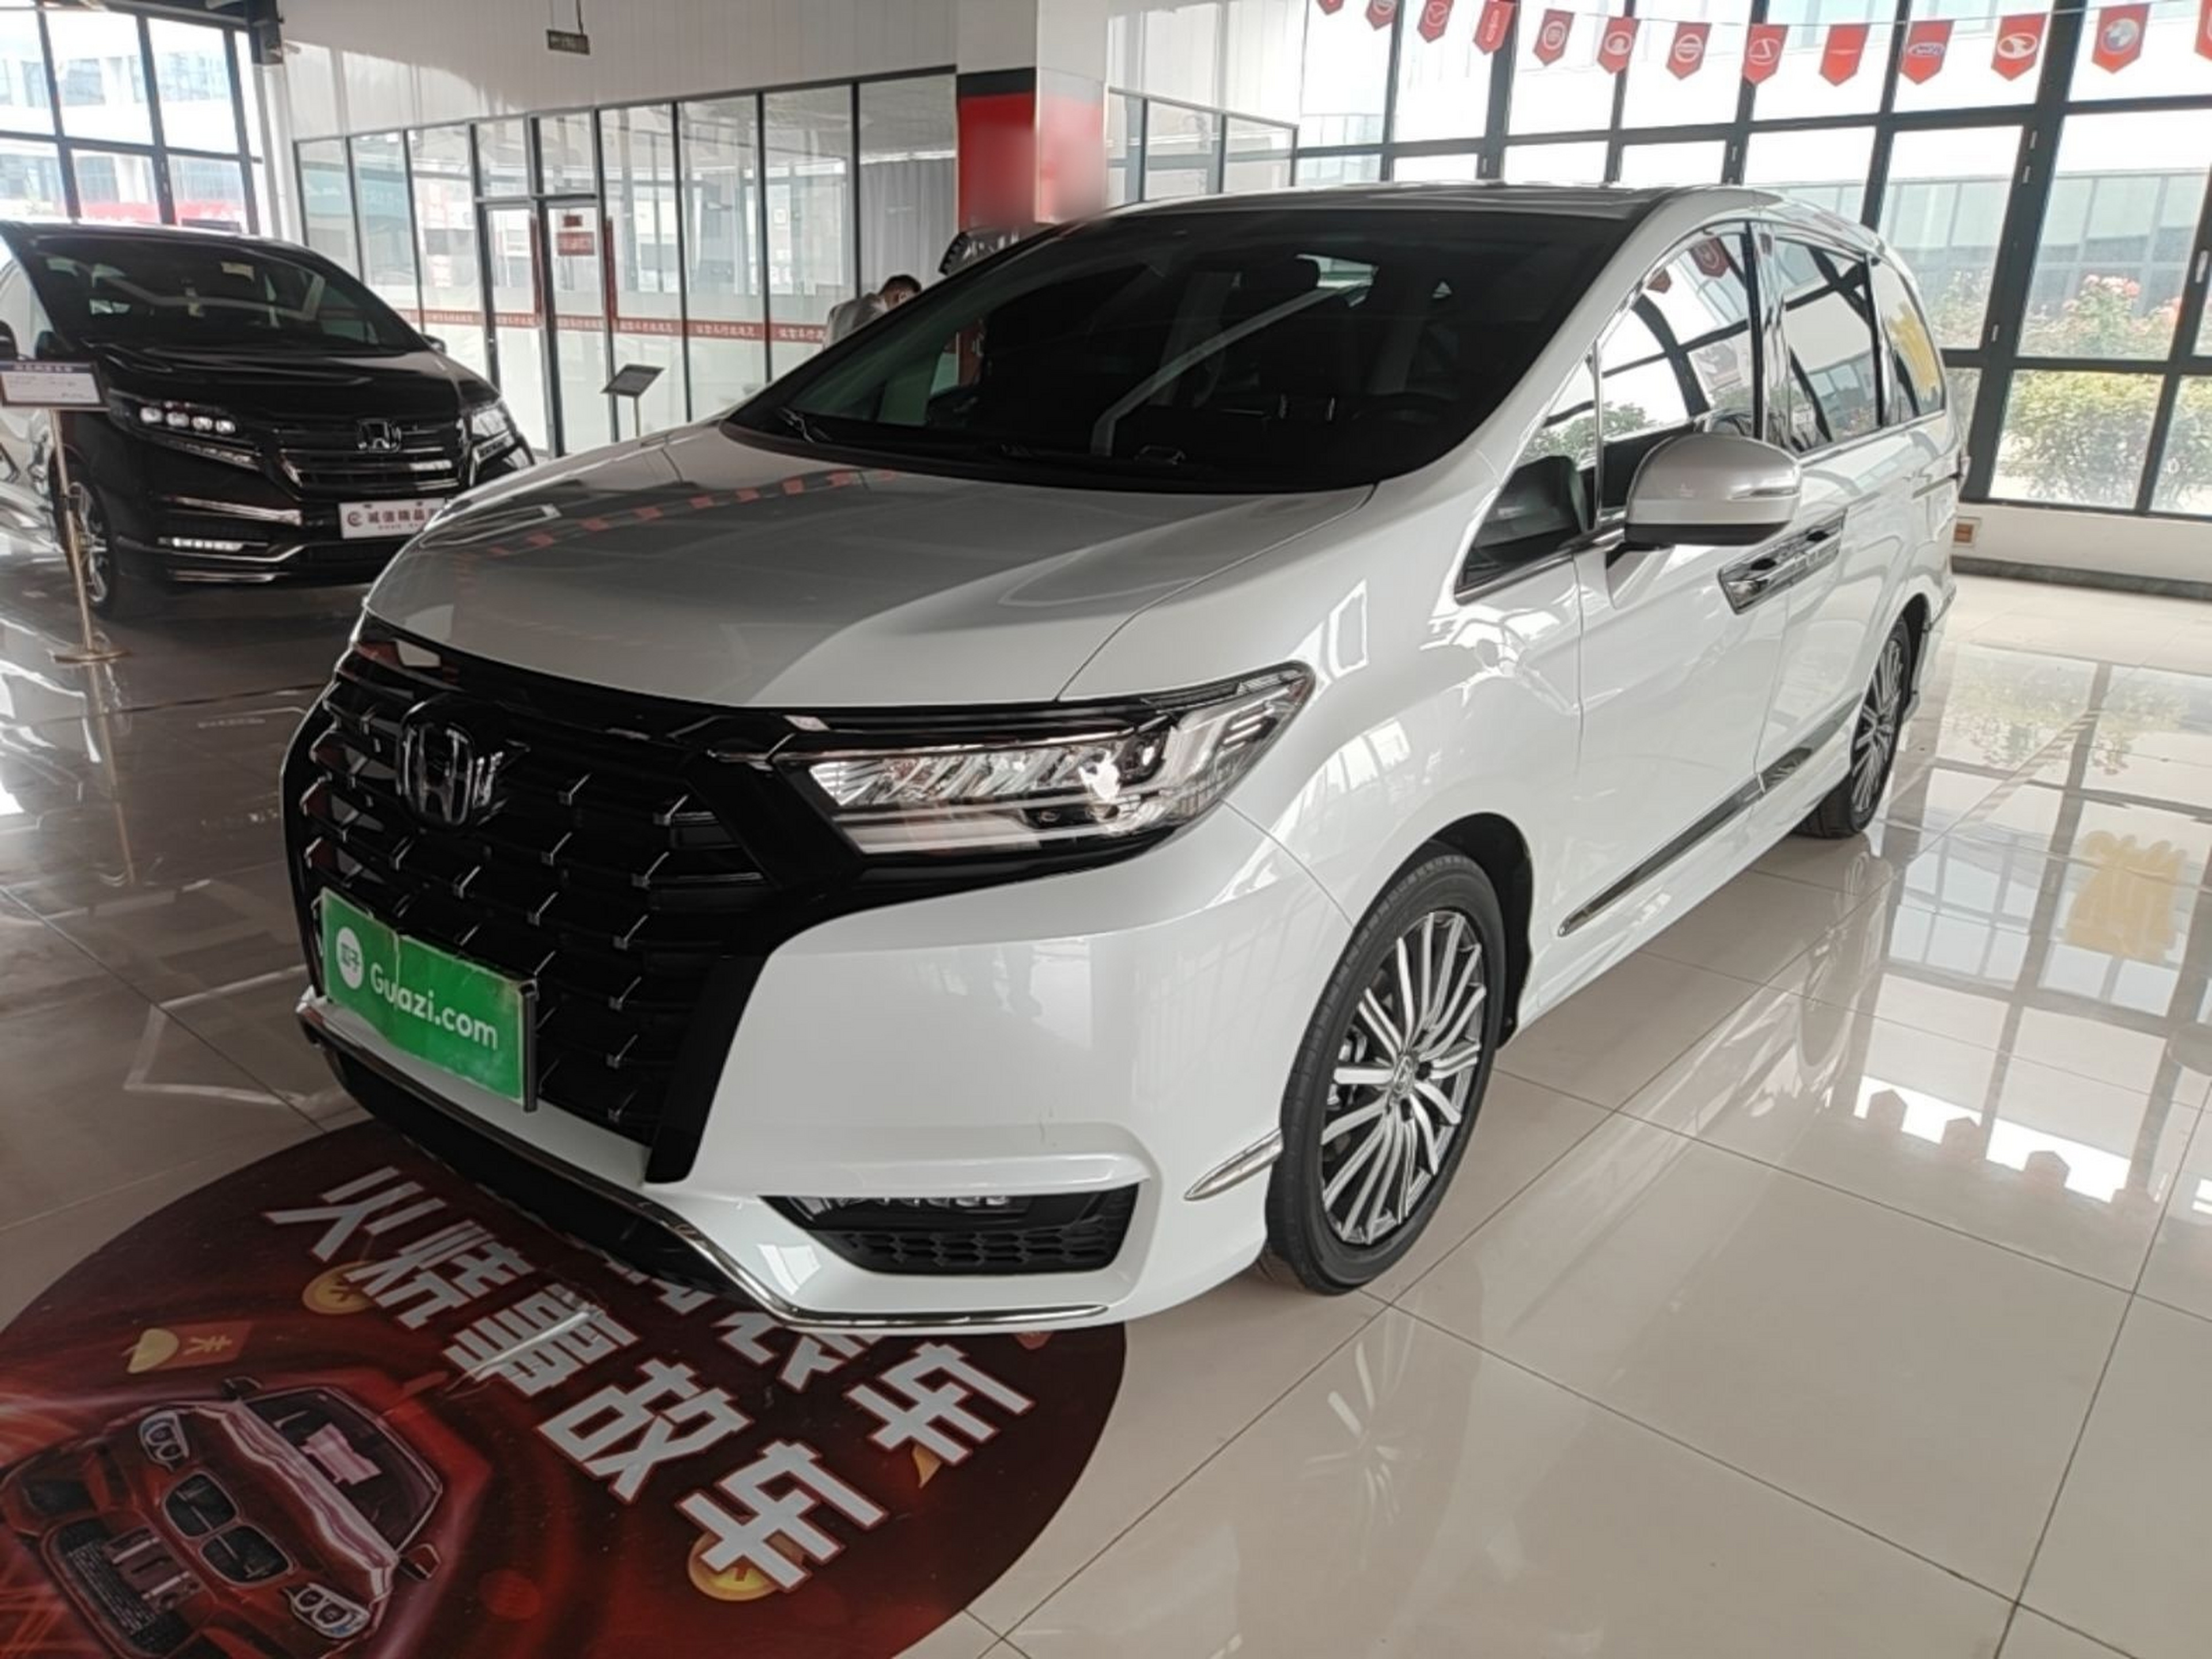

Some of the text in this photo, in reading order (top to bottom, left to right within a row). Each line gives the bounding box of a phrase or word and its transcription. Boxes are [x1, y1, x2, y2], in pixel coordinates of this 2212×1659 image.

[370, 963, 498, 1051] Guazi.com
[263, 1165, 884, 1588] 火烧事故车
